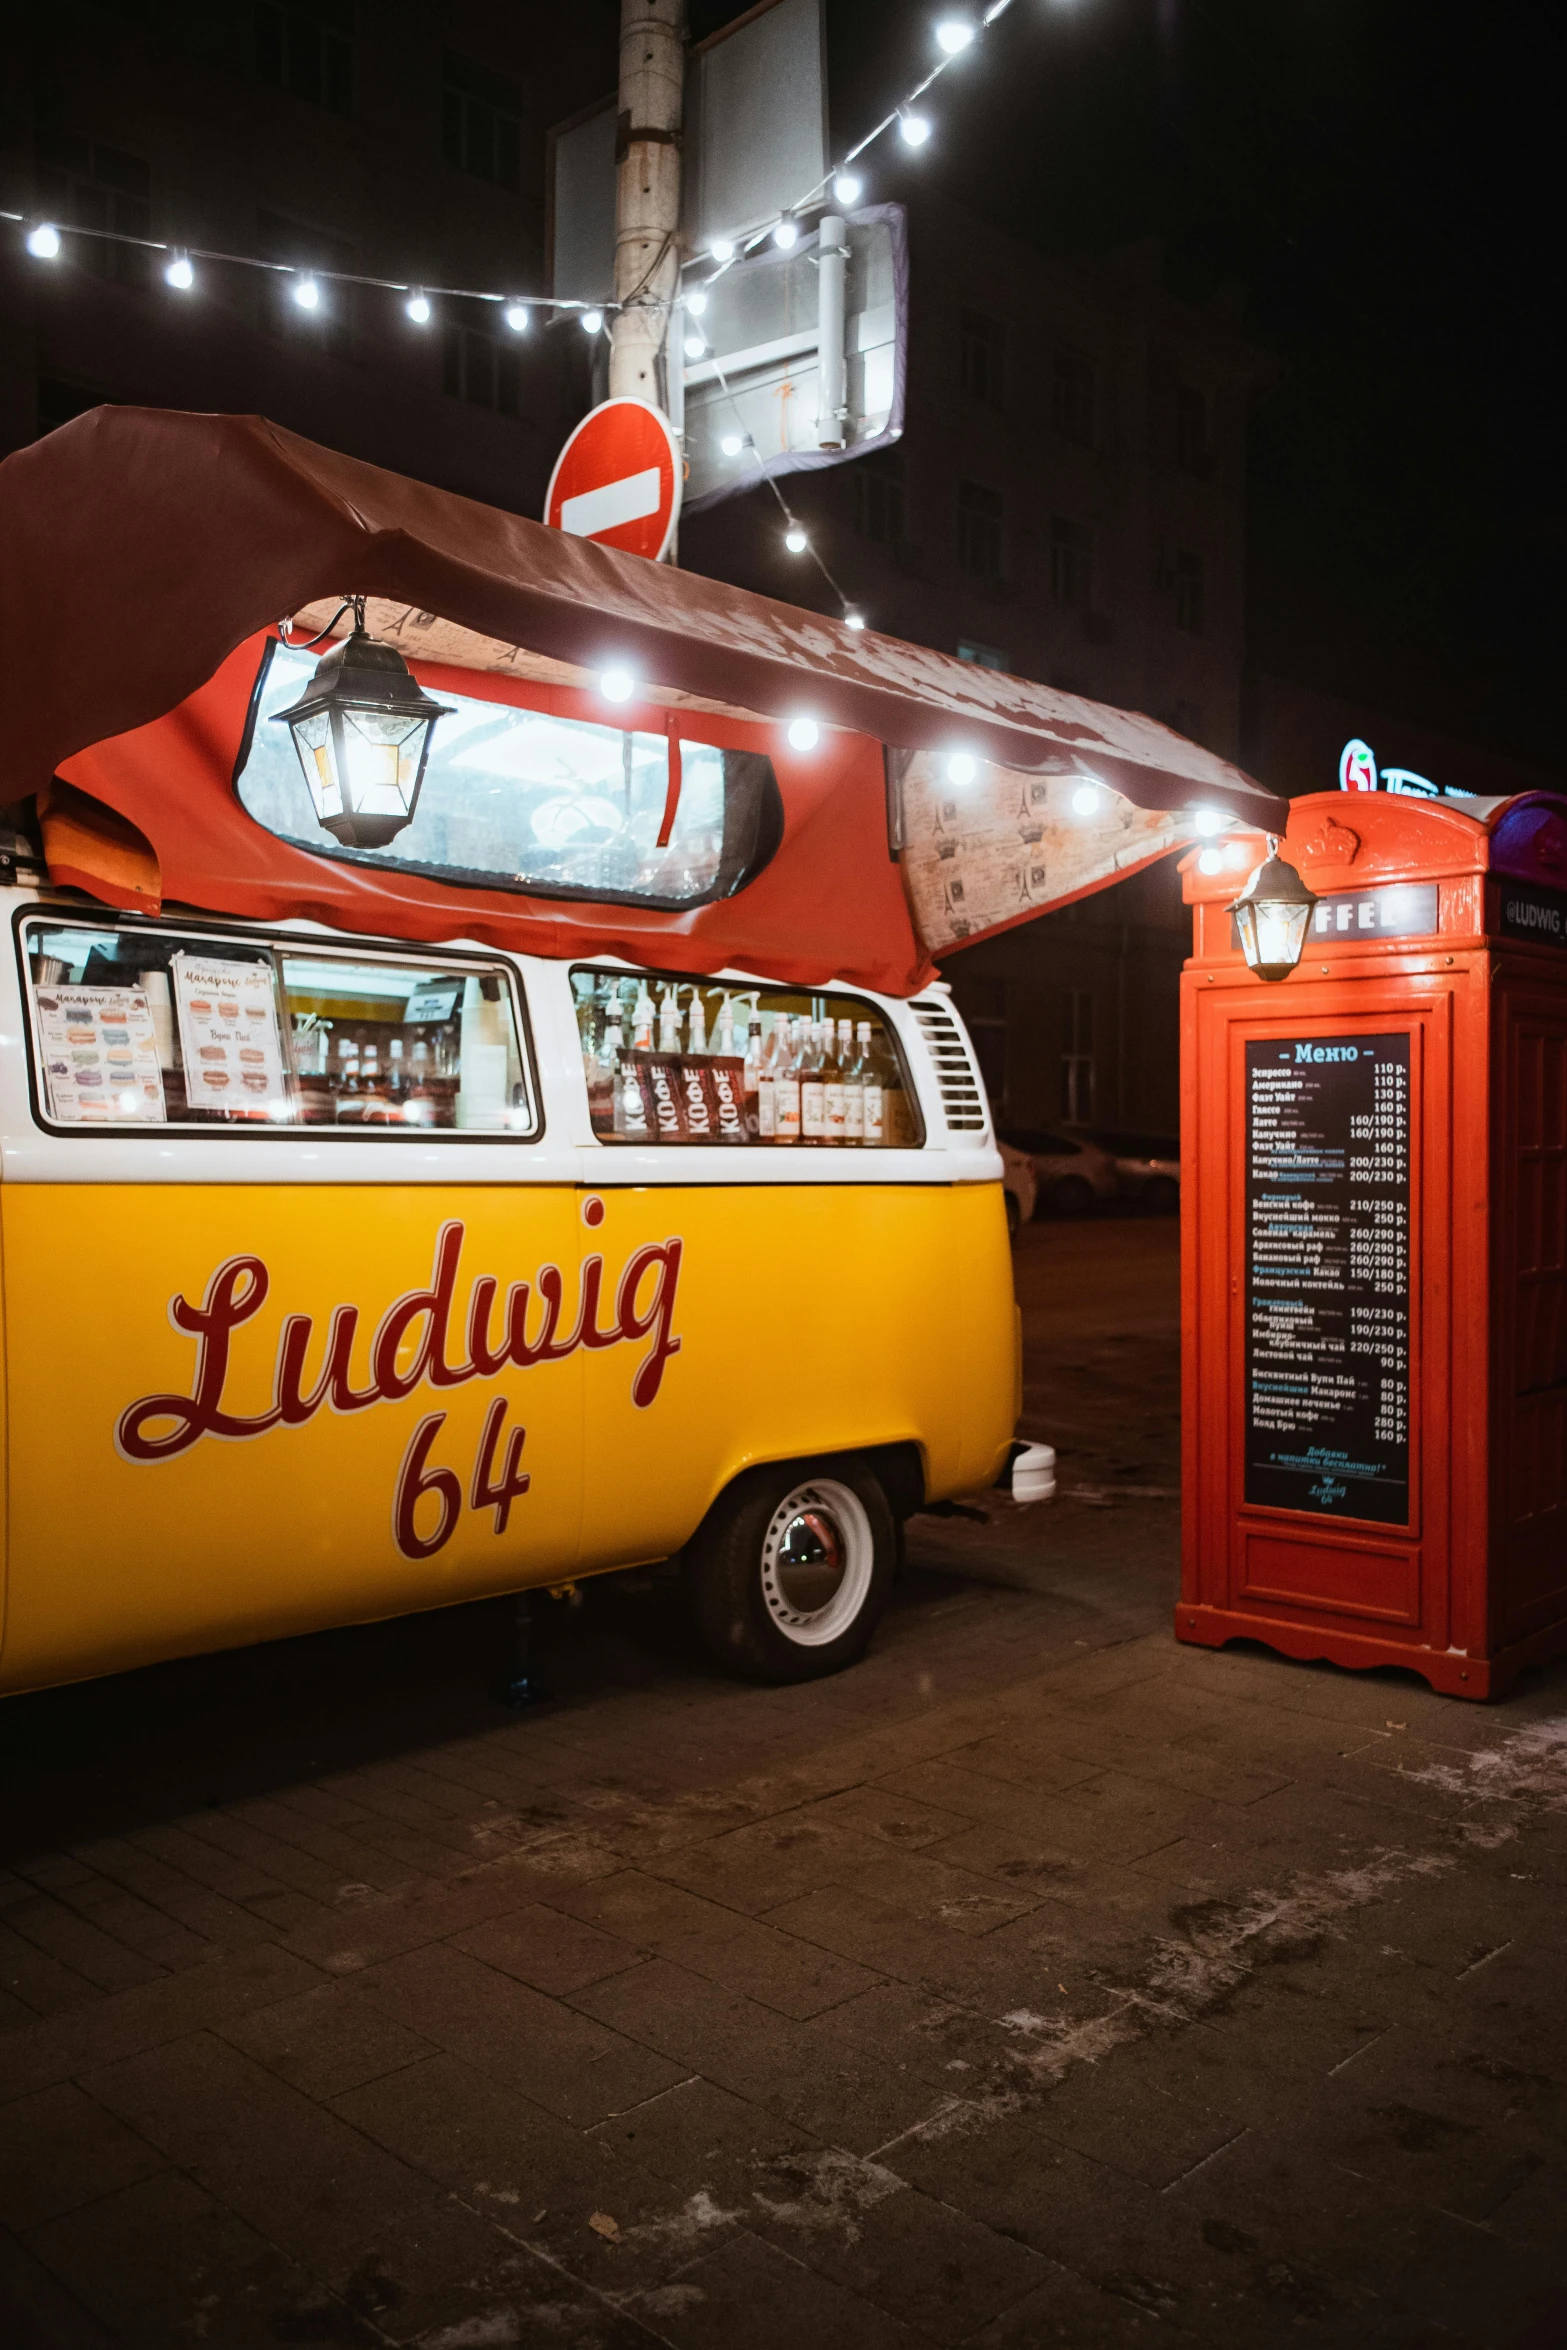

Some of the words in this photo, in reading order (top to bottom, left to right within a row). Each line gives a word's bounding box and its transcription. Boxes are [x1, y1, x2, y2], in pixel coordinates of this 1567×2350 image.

[1507, 900, 1567, 940] @LUDWIG_
[1295, 1043, 1358, 1064] Меню
[1252, 1067, 1292, 1079] Эспрессо
[1374, 1063, 1394, 1075] 110
[1396, 1064, 1406, 1076] р.
[1252, 1080, 1303, 1092] Американо
[1374, 1075, 1394, 1087] 110
[1396, 1076, 1406, 1088] р.
[650, 1065, 680, 1133] КОФЕ
[683, 1068, 710, 1134] КОФЕ
[712, 1068, 741, 1134] КОФЕ
[1252, 1092, 1274, 1102] Флэт
[1274, 1092, 1296, 1102] Уайт
[1374, 1088, 1394, 1100] 130
[1396, 1090, 1406, 1102] р.
[1374, 1102, 1394, 1113] 160
[1396, 1103, 1406, 1114] р.
[1252, 1117, 1278, 1127] Латте
[1350, 1114, 1394, 1128] 160/190
[1396, 1116, 1406, 1128] р.
[1252, 1129, 1296, 1141] Капучино
[1350, 1127, 1394, 1141] 160/190
[1396, 1128, 1406, 1140] р.
[1252, 1140, 1274, 1150] Флэт
[1274, 1140, 1296, 1150] Уайт
[1374, 1142, 1394, 1154] 160
[1396, 1144, 1406, 1156] р.
[1252, 1154, 1320, 1166] Капучино/Латте
[1350, 1156, 1394, 1170] 200/230
[1396, 1158, 1406, 1170] р.
[1252, 1169, 1278, 1179] Какао
[1350, 1170, 1394, 1184] 200/230
[1396, 1172, 1406, 1184] р.
[1252, 1198, 1290, 1209] Венский
[1292, 1199, 1315, 1211] кофе
[1350, 1200, 1394, 1213] 210/250
[1396, 1202, 1406, 1214] р.
[1252, 1211, 1310, 1223] Вкуснейший
[1311, 1214, 1340, 1223] мокко
[1374, 1213, 1394, 1224] 250
[1396, 1215, 1406, 1226] р.
[1292, 1230, 1336, 1240] карамель
[1350, 1228, 1394, 1242] 260/290
[1396, 1231, 1406, 1242] р.
[1252, 1240, 1304, 1251] Арахисовый
[1306, 1241, 1324, 1253] раф
[1350, 1242, 1394, 1255] 260/290
[1396, 1244, 1406, 1256] р.
[1252, 1252, 1302, 1262] Банановый
[1303, 1254, 1320, 1265] раф
[1350, 1254, 1394, 1268] 260/290
[1396, 1258, 1406, 1270] р.
[1313, 1267, 1340, 1278] Какао
[1350, 1267, 1394, 1281] 150/180
[1396, 1271, 1406, 1282] р.
[1252, 1276, 1300, 1288] Молочный
[1302, 1280, 1345, 1290] коктейль
[1374, 1282, 1394, 1293] 250
[1396, 1284, 1406, 1296] р.
[1350, 1307, 1394, 1320] 190/230
[1396, 1312, 1406, 1322] р.
[114, 1194, 684, 1466] Ludwig
[1350, 1324, 1394, 1338] 190/230
[1396, 1328, 1406, 1340] р.
[1269, 1339, 1326, 1350] клубничный
[1328, 1342, 1346, 1352] чай
[1350, 1341, 1394, 1356] 220/250
[1396, 1346, 1406, 1358] р.
[1253, 1348, 1295, 1360] Листовой
[1296, 1352, 1314, 1362] чай
[1380, 1356, 1394, 1368] 90
[1396, 1360, 1406, 1371] р.
[1252, 1368, 1308, 1382] Бисквитный
[1310, 1373, 1334, 1385] Вупи
[1336, 1375, 1355, 1386] Пай
[1380, 1378, 1394, 1390] 80
[1396, 1381, 1406, 1392] р.
[1252, 1393, 1301, 1405] Домашнее
[1302, 1398, 1342, 1411] печенье
[1380, 1404, 1394, 1416] 80
[1396, 1407, 1406, 1418] р.
[1380, 1391, 1394, 1402] 80
[1396, 1394, 1406, 1406] р.
[1252, 1405, 1294, 1418] Молотый
[1296, 1410, 1320, 1422] кофе
[1374, 1416, 1394, 1428] 280
[1396, 1420, 1406, 1432] р.
[1253, 1417, 1276, 1430] Колд
[1276, 1420, 1296, 1432] Брю
[1375, 1429, 1394, 1442] 160
[1396, 1432, 1406, 1444] р.
[1278, 1454, 1320, 1466] напитки
[392, 1395, 531, 1562] 64
[1308, 1484, 1347, 1498] Ludwig
